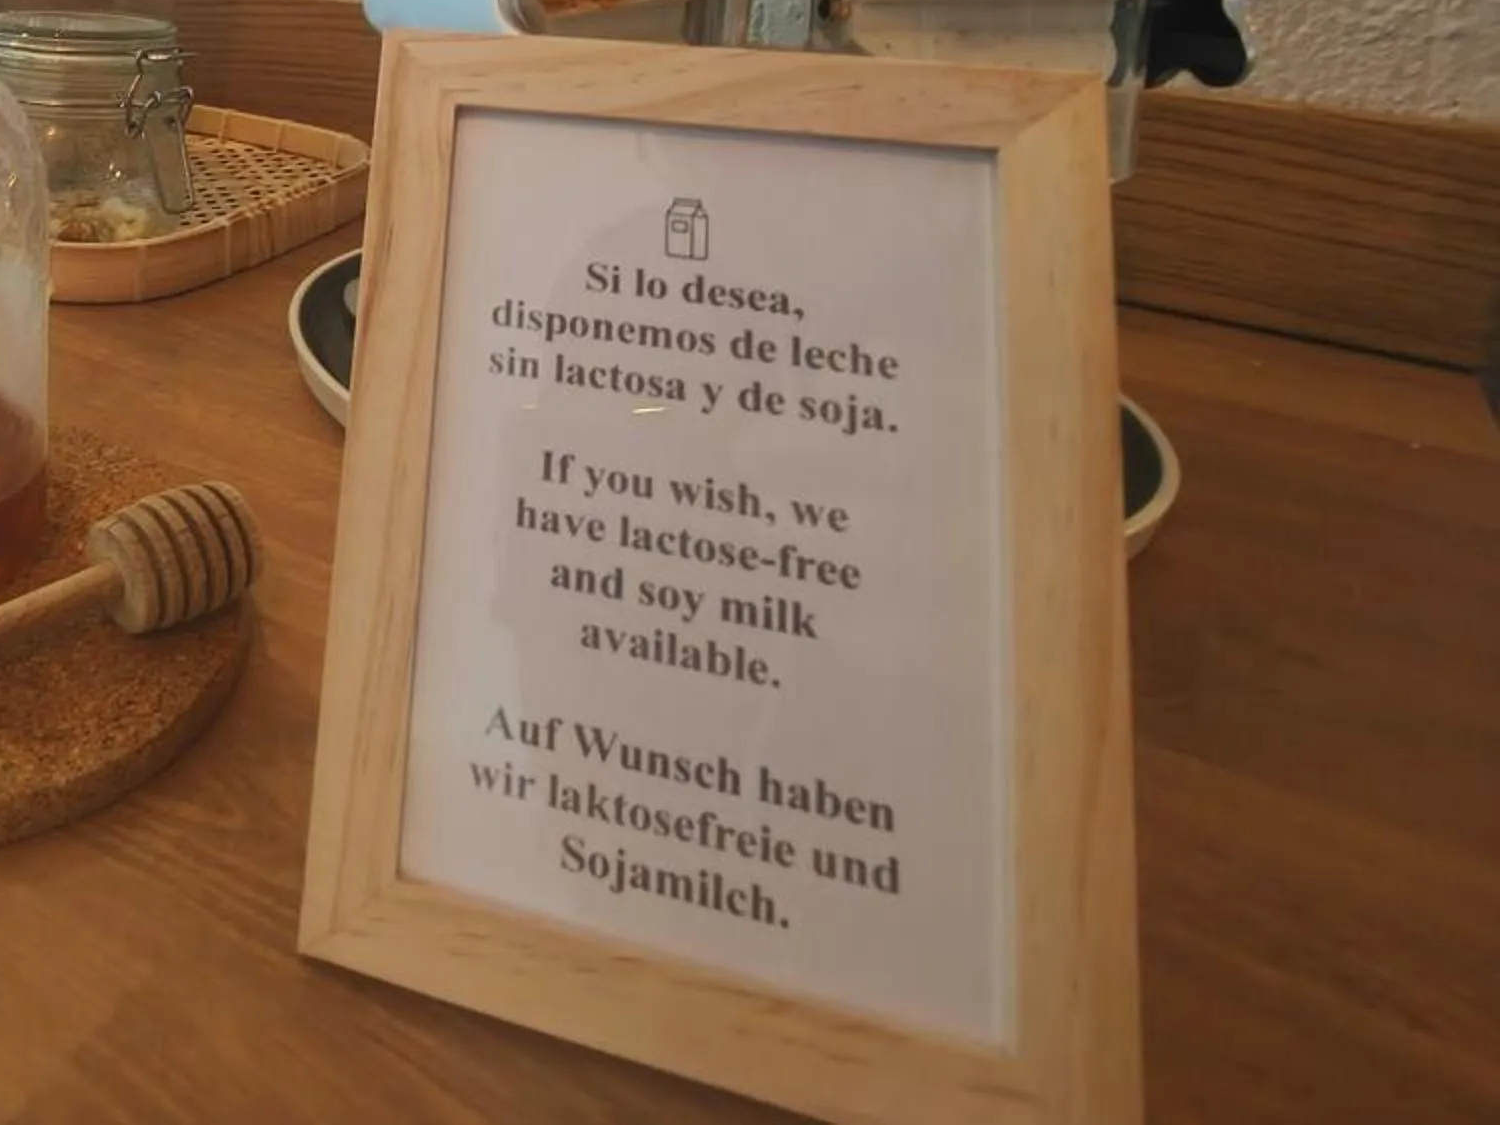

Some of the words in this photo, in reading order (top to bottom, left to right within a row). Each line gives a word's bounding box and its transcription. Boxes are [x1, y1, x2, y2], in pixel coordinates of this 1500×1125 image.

[585, 262, 621, 295] Si
[635, 268, 669, 300] lo
[681, 274, 805, 323] desea,
[491, 299, 717, 357] disponemos
[730, 329, 778, 365] de
[791, 335, 900, 381] leche
[489, 347, 539, 380] sin
[555, 353, 687, 402] lactosa
[701, 382, 724, 416] y
[737, 380, 786, 417] de
[799, 394, 899, 436] soja.
[541, 450, 577, 485] If
[584, 465, 654, 500] you
[669, 477, 777, 526] wish,
[791, 501, 850, 534] we
[516, 496, 607, 544] have
[620, 515, 862, 591] lactose-free
[550, 565, 624, 602] and
[638, 581, 706, 624] soy
[720, 595, 818, 640] milk
[580, 624, 781, 689] available.
[485, 706, 565, 753] Auf
[573, 722, 742, 797] Wunsch
[759, 766, 895, 833] haben
[470, 762, 537, 801] wir
[548, 773, 796, 869] laktosefreie
[812, 848, 901, 896] und
[560, 835, 790, 930] Sojamilch.
